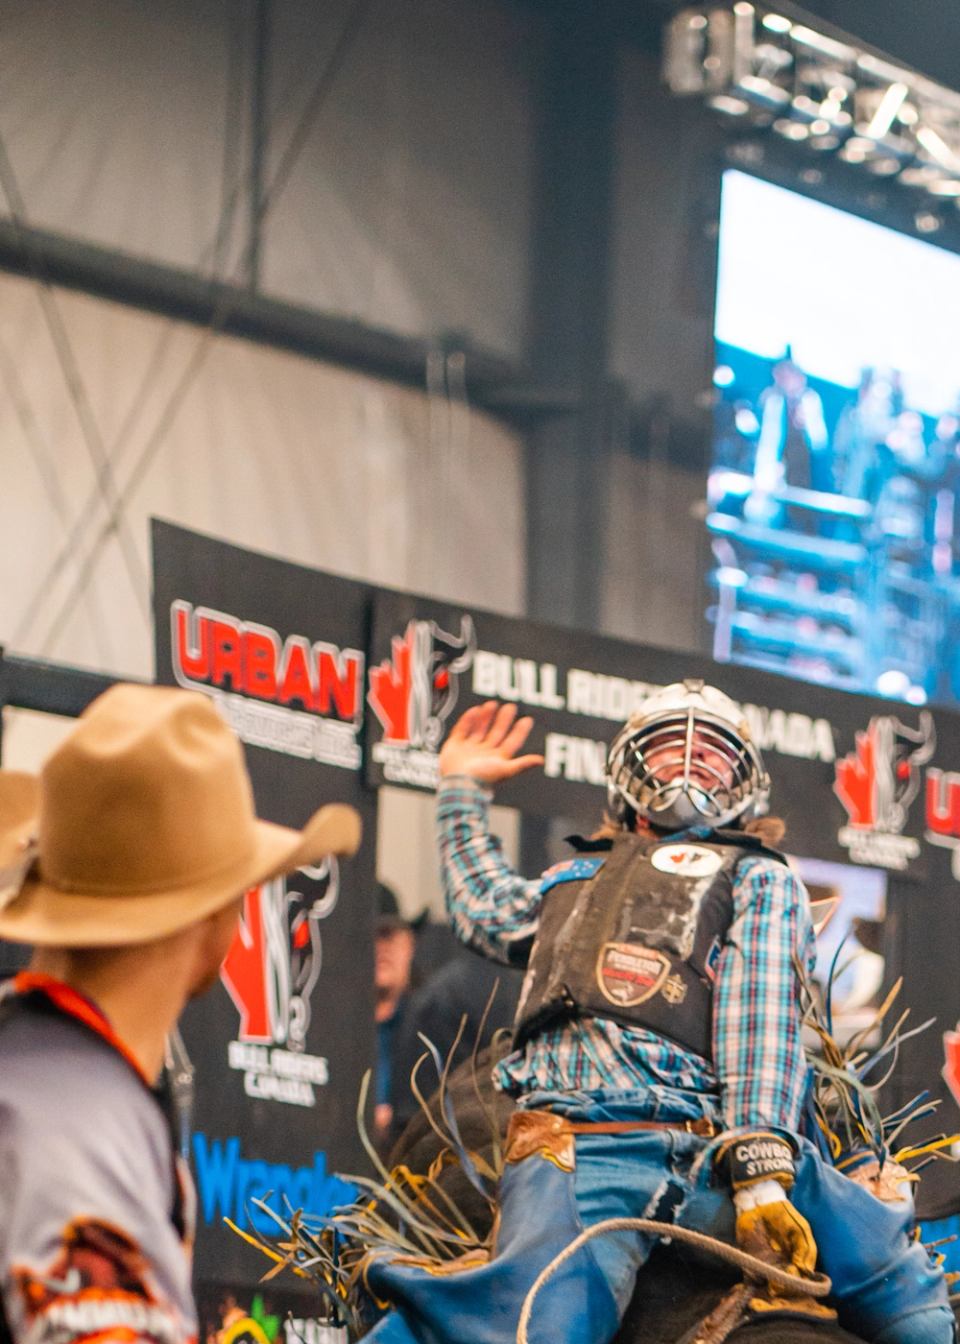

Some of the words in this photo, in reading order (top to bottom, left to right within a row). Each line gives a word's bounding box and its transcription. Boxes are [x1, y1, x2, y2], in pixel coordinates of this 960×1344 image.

[172, 600, 364, 723] URBAN
[472, 650, 565, 711] BULL
[736, 1143, 792, 1162] COWBO
[746, 1159, 795, 1176] STRON
